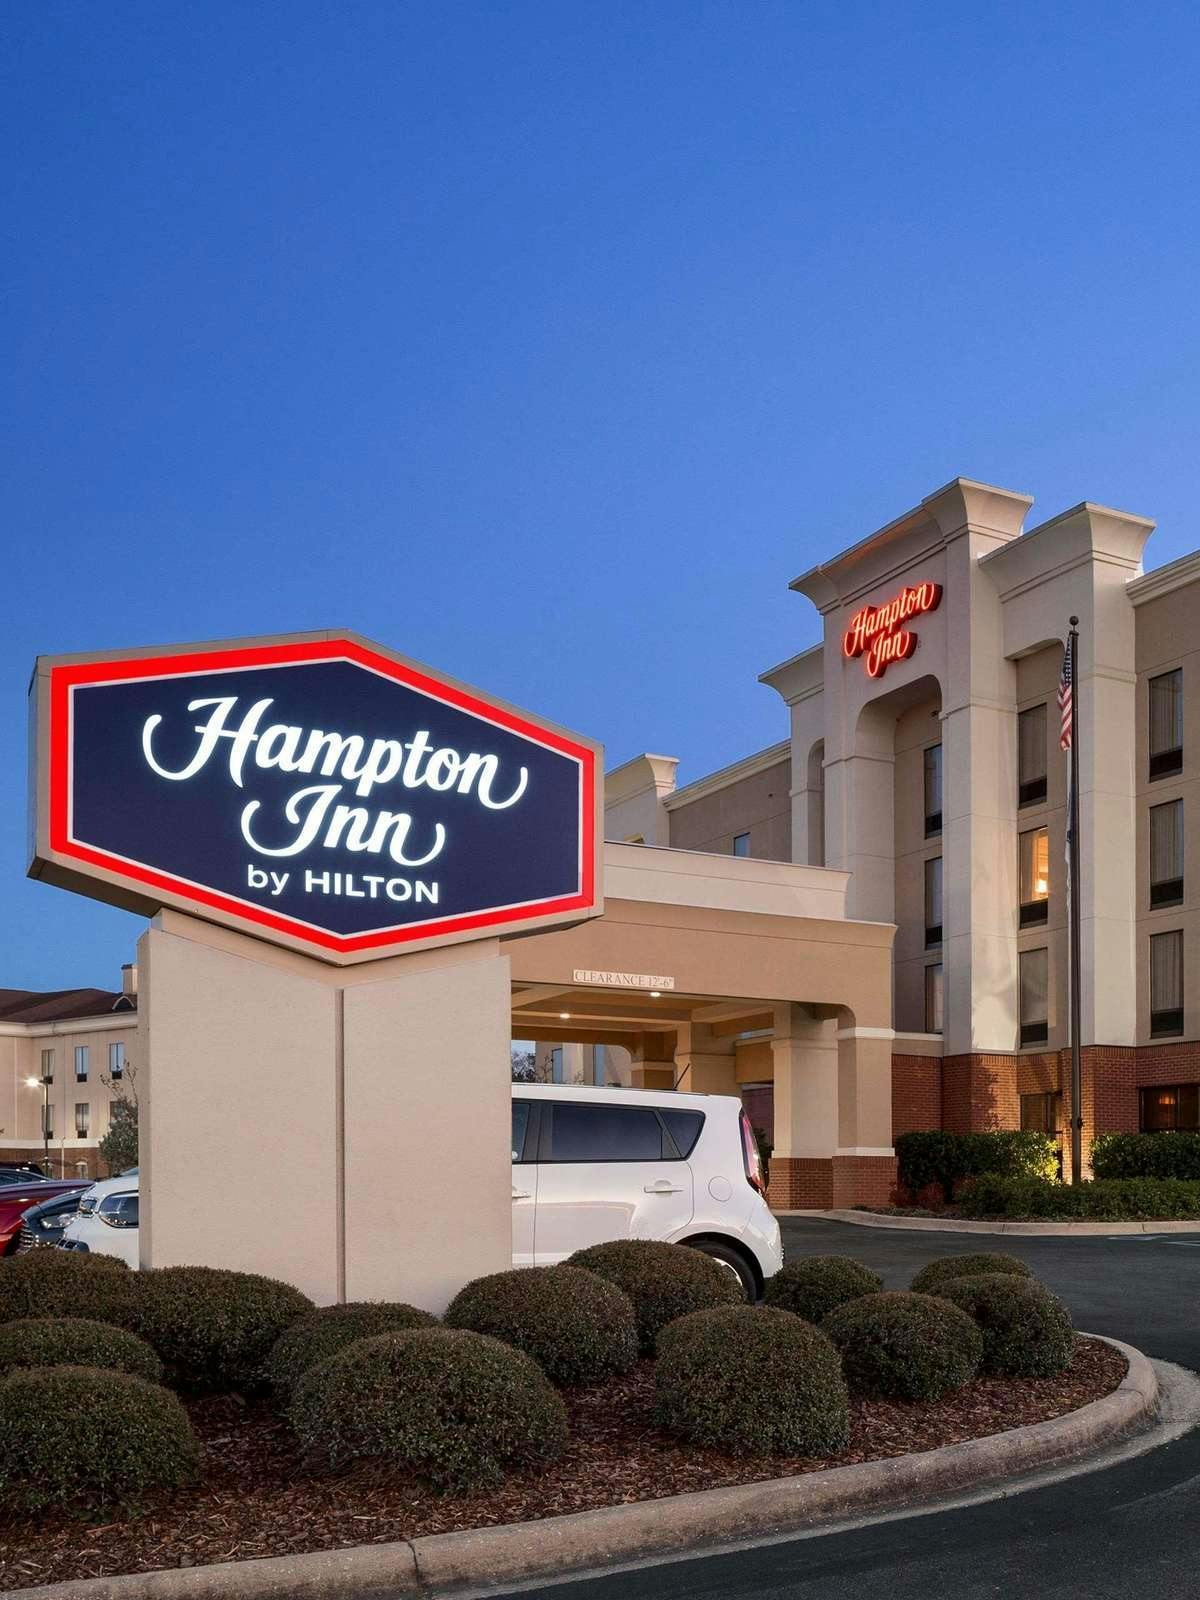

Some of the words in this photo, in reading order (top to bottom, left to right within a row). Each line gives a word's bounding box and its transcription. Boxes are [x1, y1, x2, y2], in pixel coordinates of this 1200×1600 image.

[844, 583, 942, 657] Hampton
[867, 631, 917, 678] Inn
[142, 696, 528, 809] Hampton
[241, 784, 445, 867] Inn
[247, 865, 290, 895] by
[304, 870, 439, 904] HILTON
[575, 970, 645, 986] CLEARANCE
